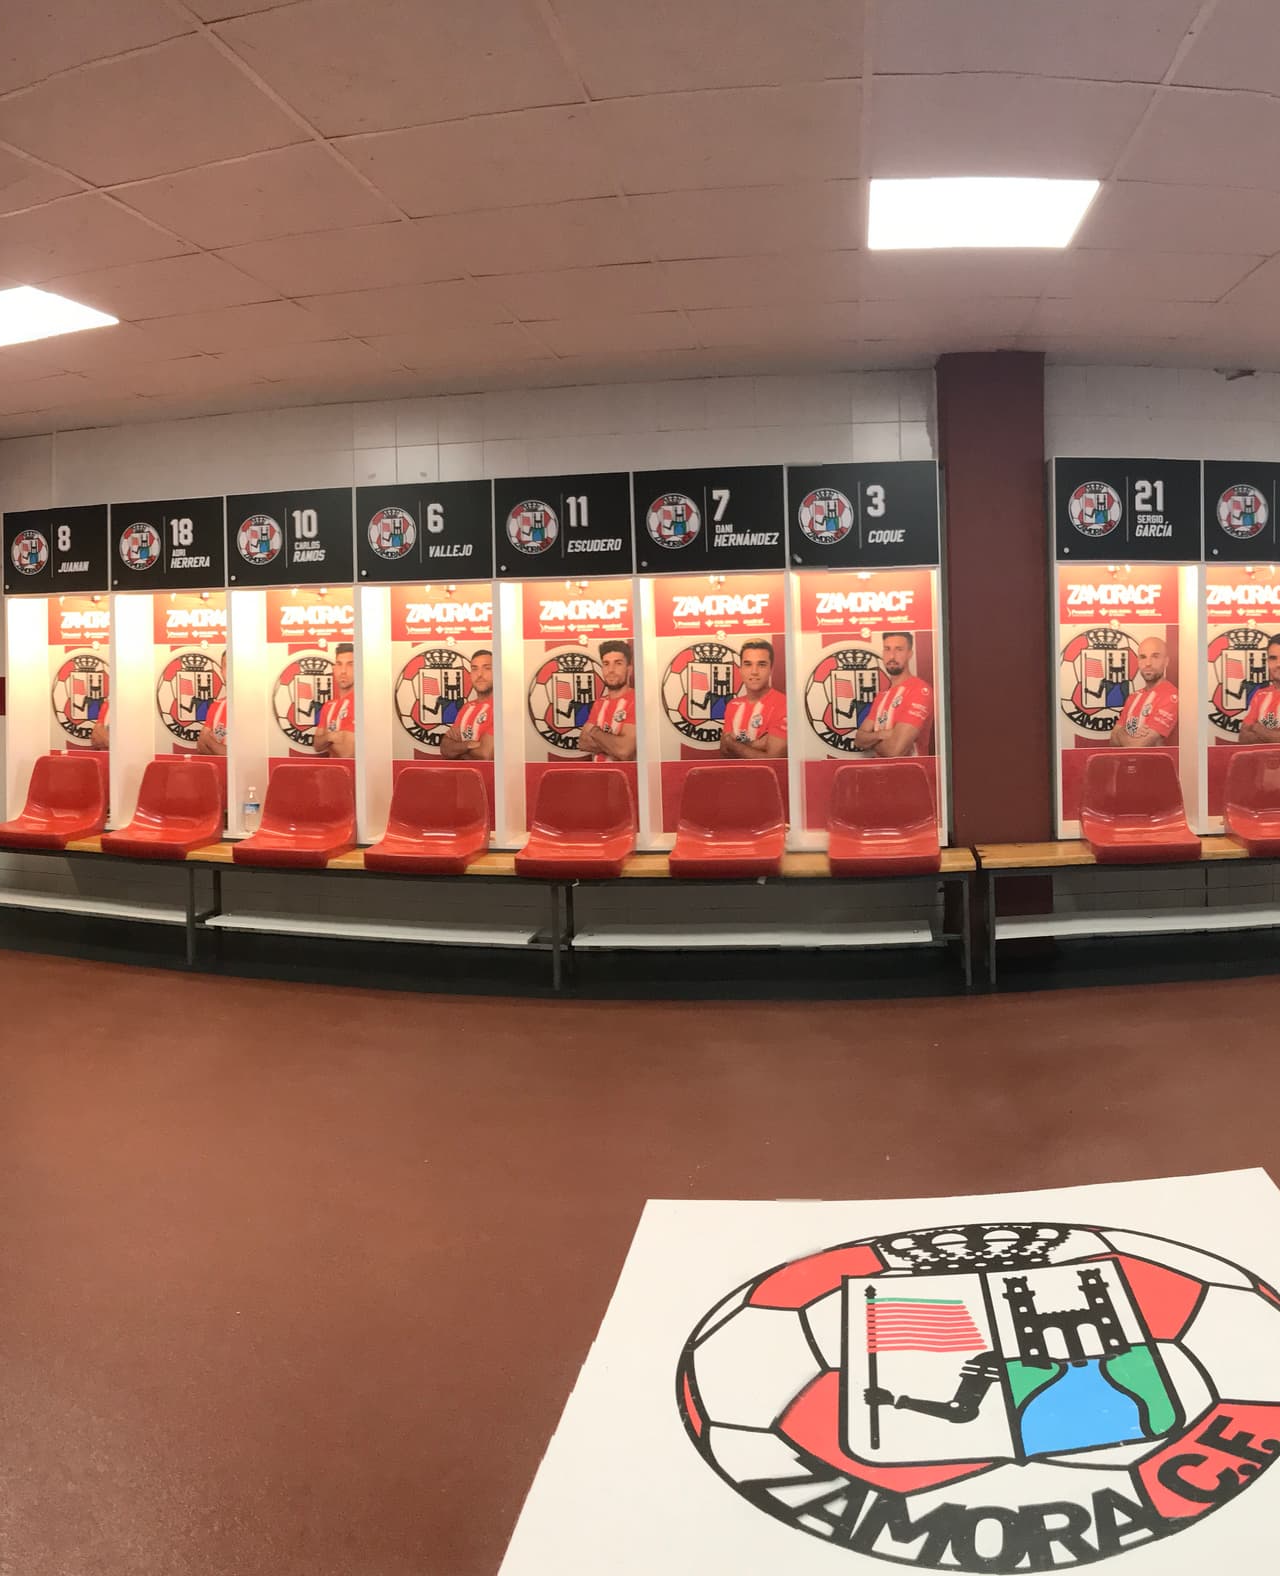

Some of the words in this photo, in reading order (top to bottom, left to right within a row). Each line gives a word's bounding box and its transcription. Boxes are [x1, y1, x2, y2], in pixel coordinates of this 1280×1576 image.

[712, 489, 730, 521] 7
[866, 485, 885, 517] 3
[1135, 480, 1164, 512] 21
[427, 503, 443, 533] 6
[566, 496, 588, 527] 11
[1137, 515, 1163, 524] SERGIO
[170, 518, 193, 546] 18
[292, 509, 318, 539] 10
[715, 524, 733, 533] DANI
[1136, 521, 1172, 537] GARCÍA
[58, 525, 71, 551] 8
[567, 538, 622, 552] ESCUDERO
[714, 529, 779, 547] HERNÁNDEZ
[868, 529, 906, 544] COQUE
[293, 550, 326, 562] RAMOS
[429, 544, 472, 557] VALLEJO
[58, 561, 89, 573] JUANAN
[171, 556, 210, 568] HERRERA
[672, 593, 769, 616] ZAMORACF
[816, 590, 914, 613] ZAMORACF
[1067, 584, 1161, 605] ZAMORACF
[280, 605, 353, 625] ZAMORAC
[539, 599, 628, 620] ZAMORACF
[738, 1453, 1160, 1573] ZAMORA
